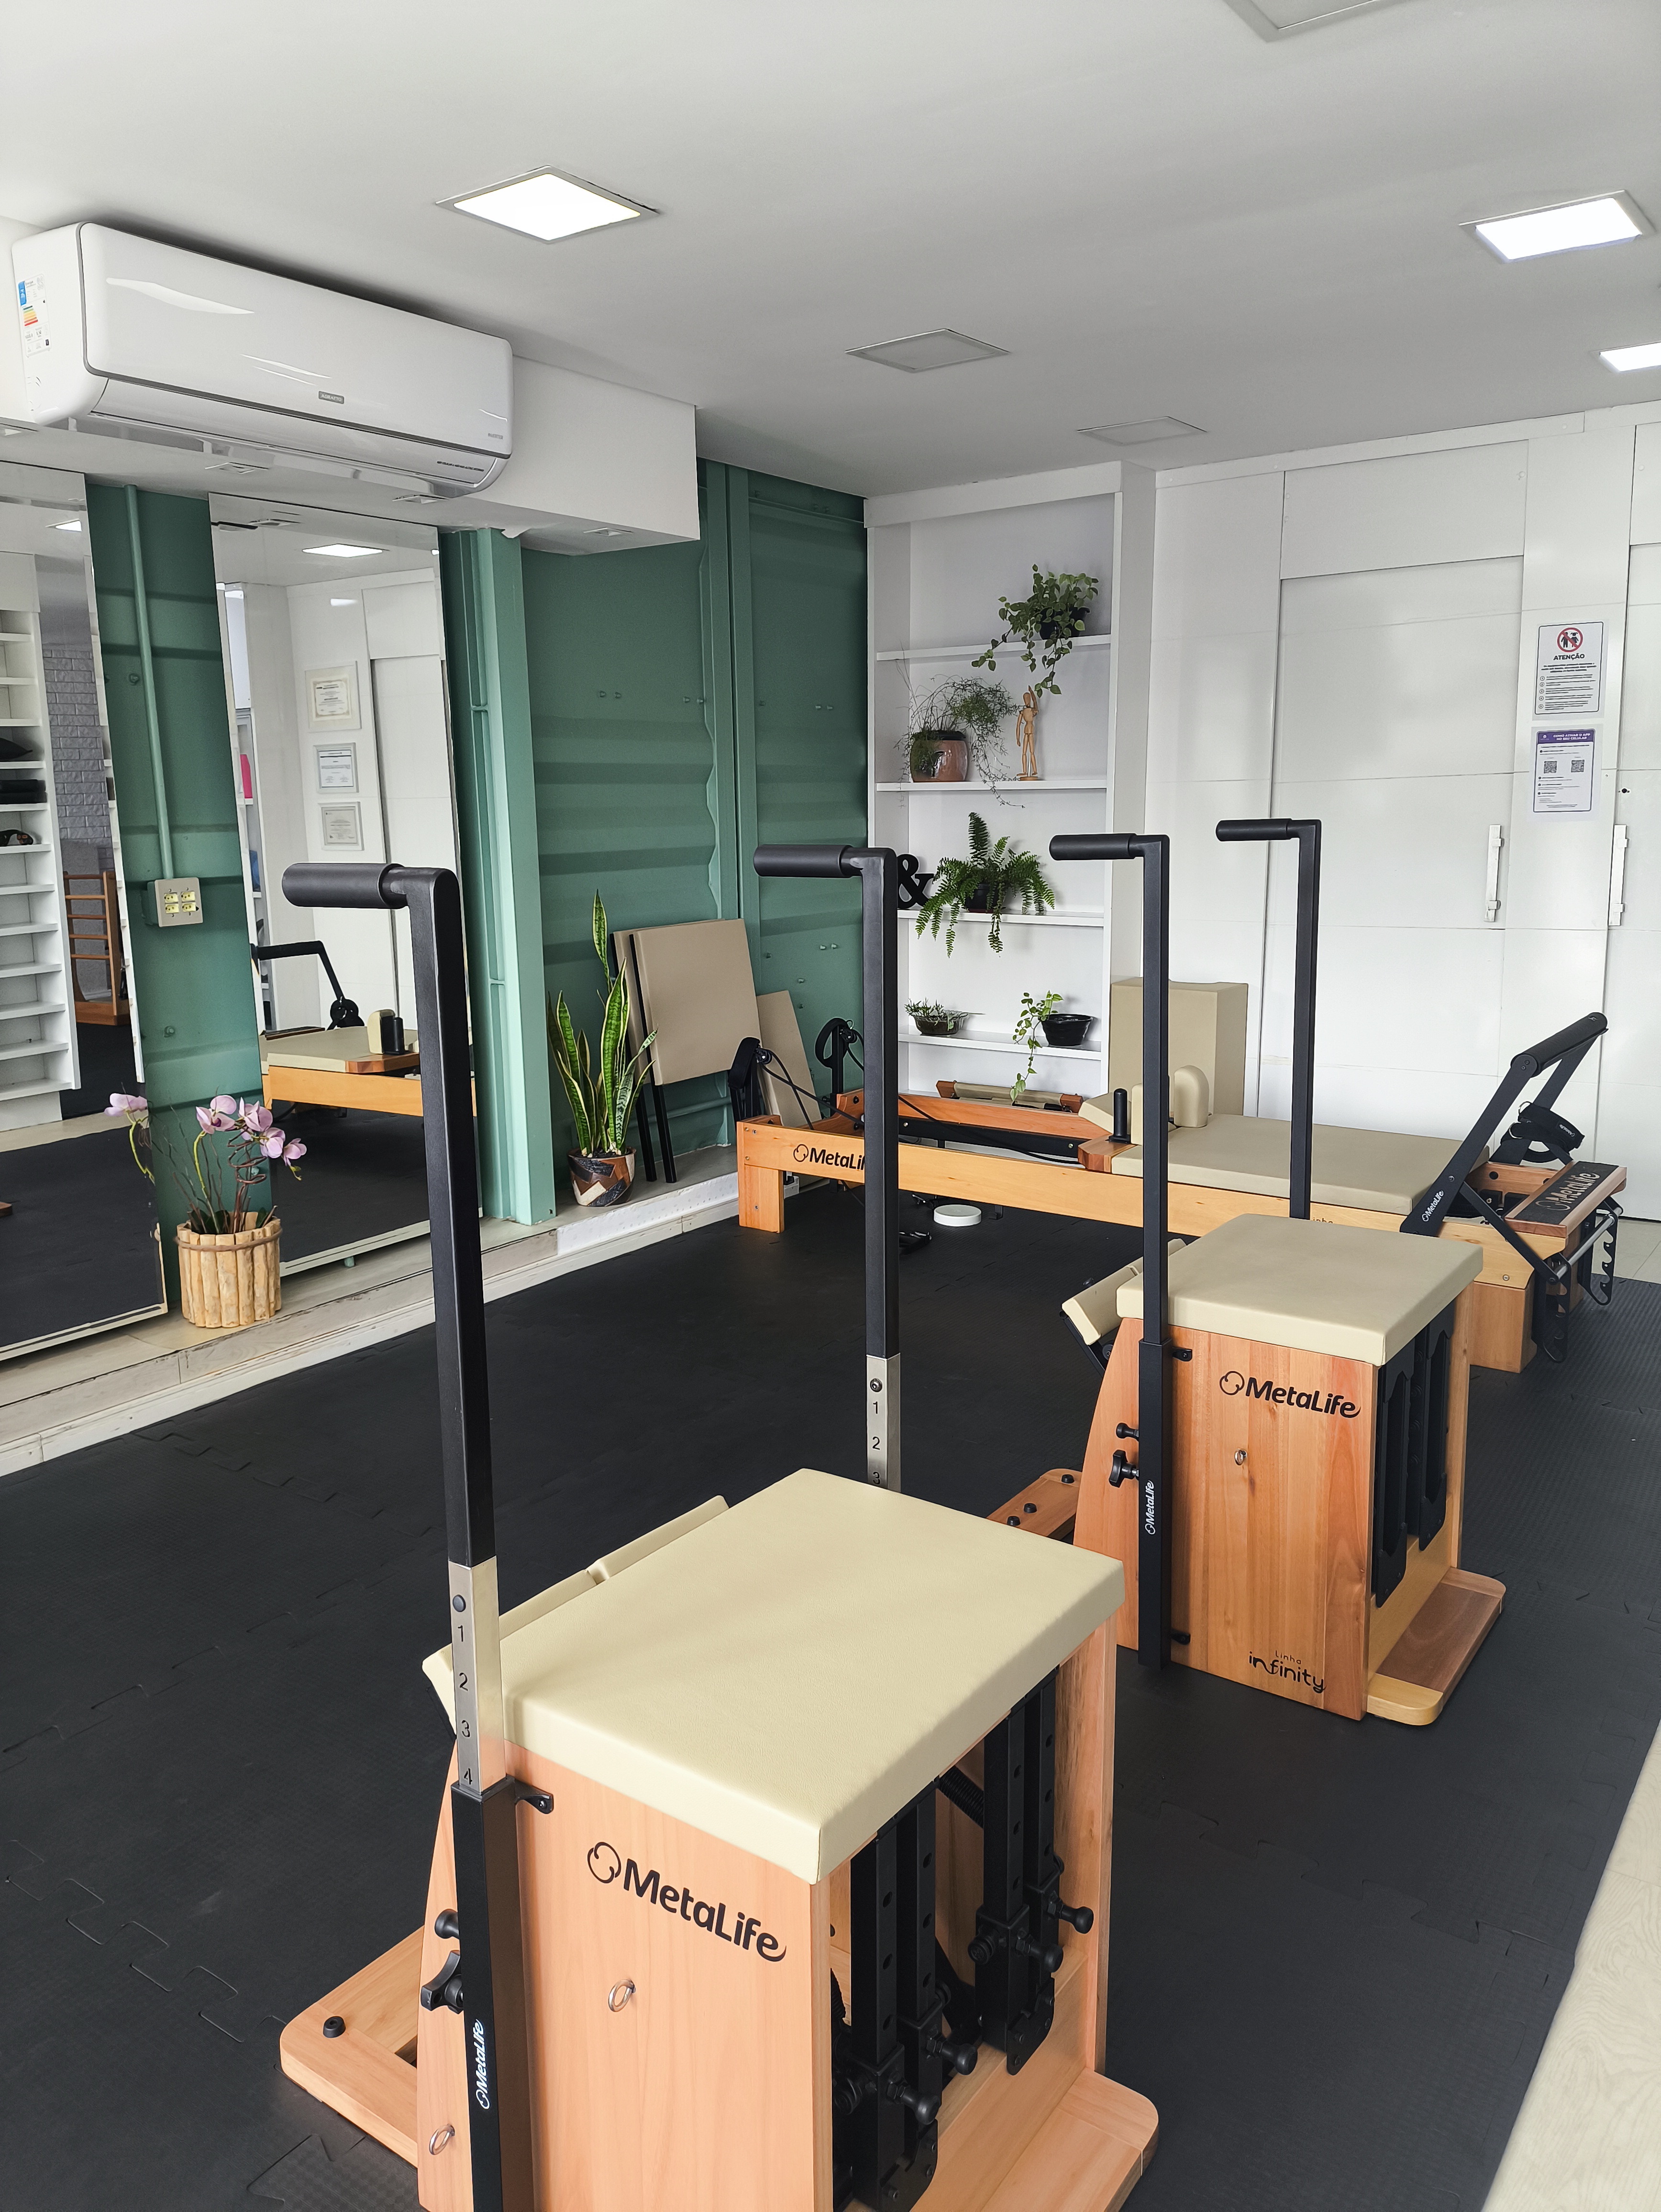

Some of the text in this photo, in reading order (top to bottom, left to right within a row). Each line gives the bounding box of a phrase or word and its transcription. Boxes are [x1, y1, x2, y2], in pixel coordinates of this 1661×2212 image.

[1553, 653, 1585, 661] ATENÇÃO
[809, 1148, 865, 1170] MetaLif
[1546, 1173, 1600, 1204] MetaLife
[1425, 1190, 1444, 1217] MetaLife
[873, 1401, 878, 1414] 1
[1245, 1377, 1361, 1418] MetaLife
[872, 1436, 880, 1450] 2
[872, 1471, 881, 1485] 3
[1145, 1480, 1154, 1526] MetaLife
[457, 1625, 464, 1642] 1
[459, 1672, 468, 1692] 2
[1249, 1651, 1327, 1694] infinity
[461, 1720, 470, 1737] 3
[463, 1768, 473, 1785] 4
[623, 1858, 787, 1962] MetaLife
[473, 2019, 488, 2094] MetaLife
